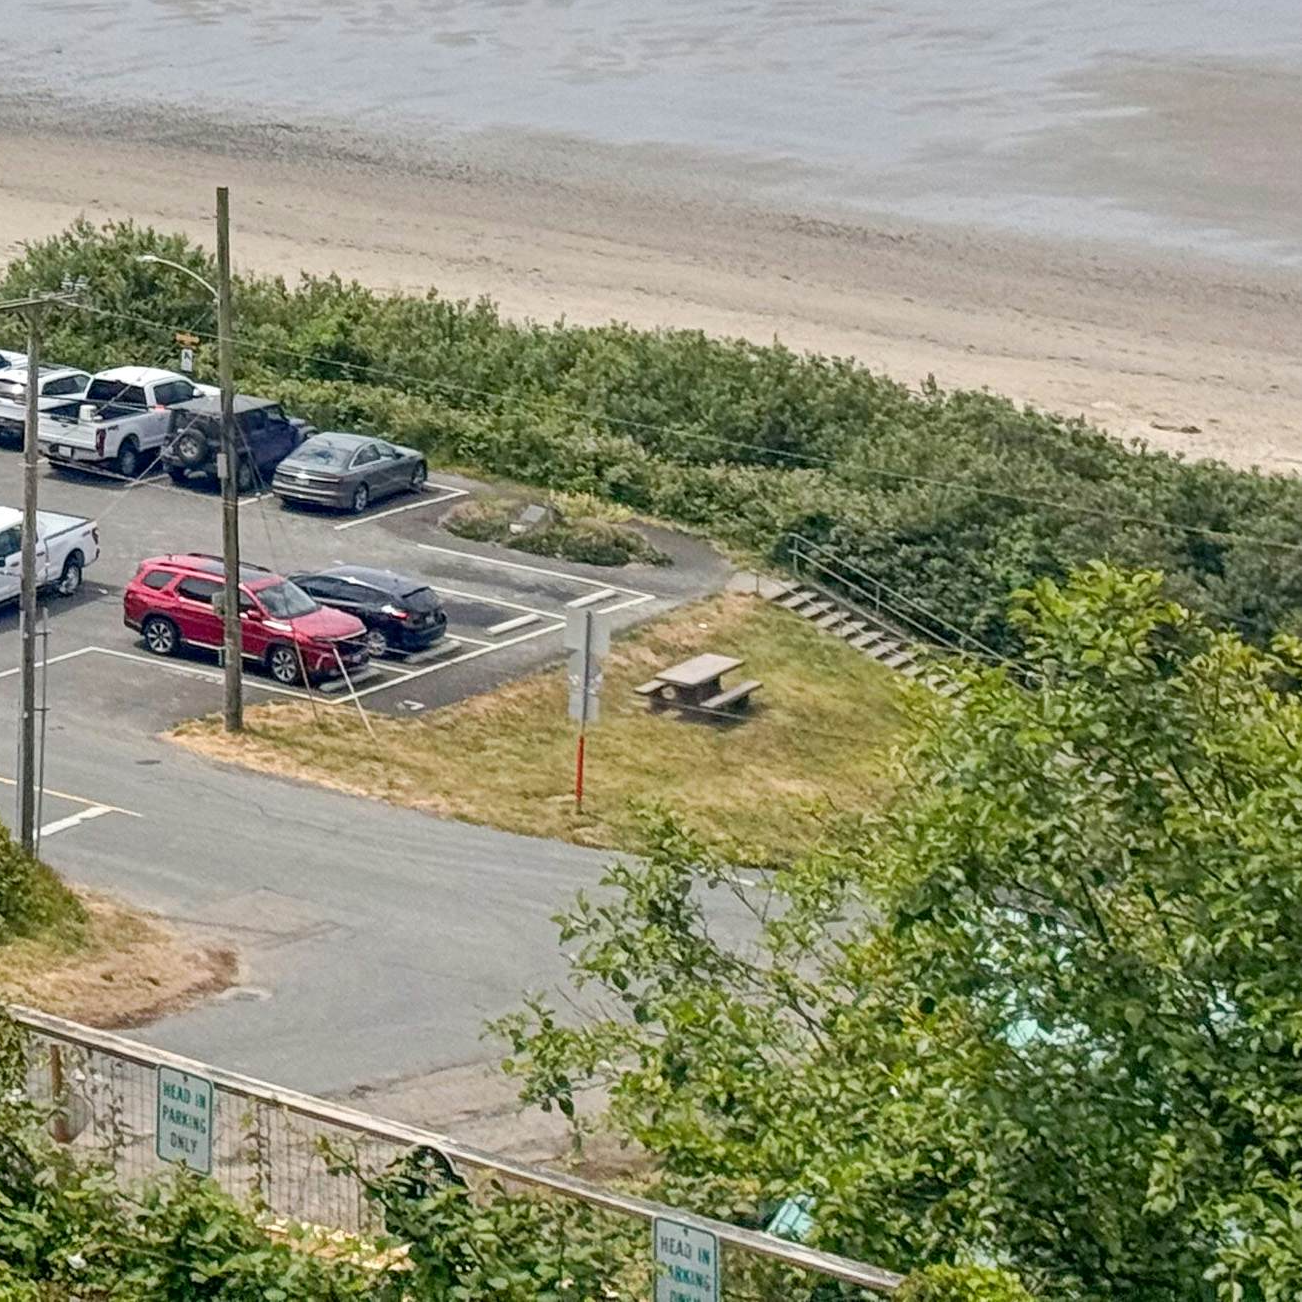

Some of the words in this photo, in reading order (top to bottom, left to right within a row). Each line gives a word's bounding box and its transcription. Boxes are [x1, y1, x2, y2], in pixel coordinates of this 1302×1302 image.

[162, 1081, 191, 1104] HEAD
[162, 1105, 207, 1134] PARKING
[170, 1132, 197, 1154] ONLY
[660, 1236, 692, 1260] HEAD
[698, 1247, 711, 1265] IN
